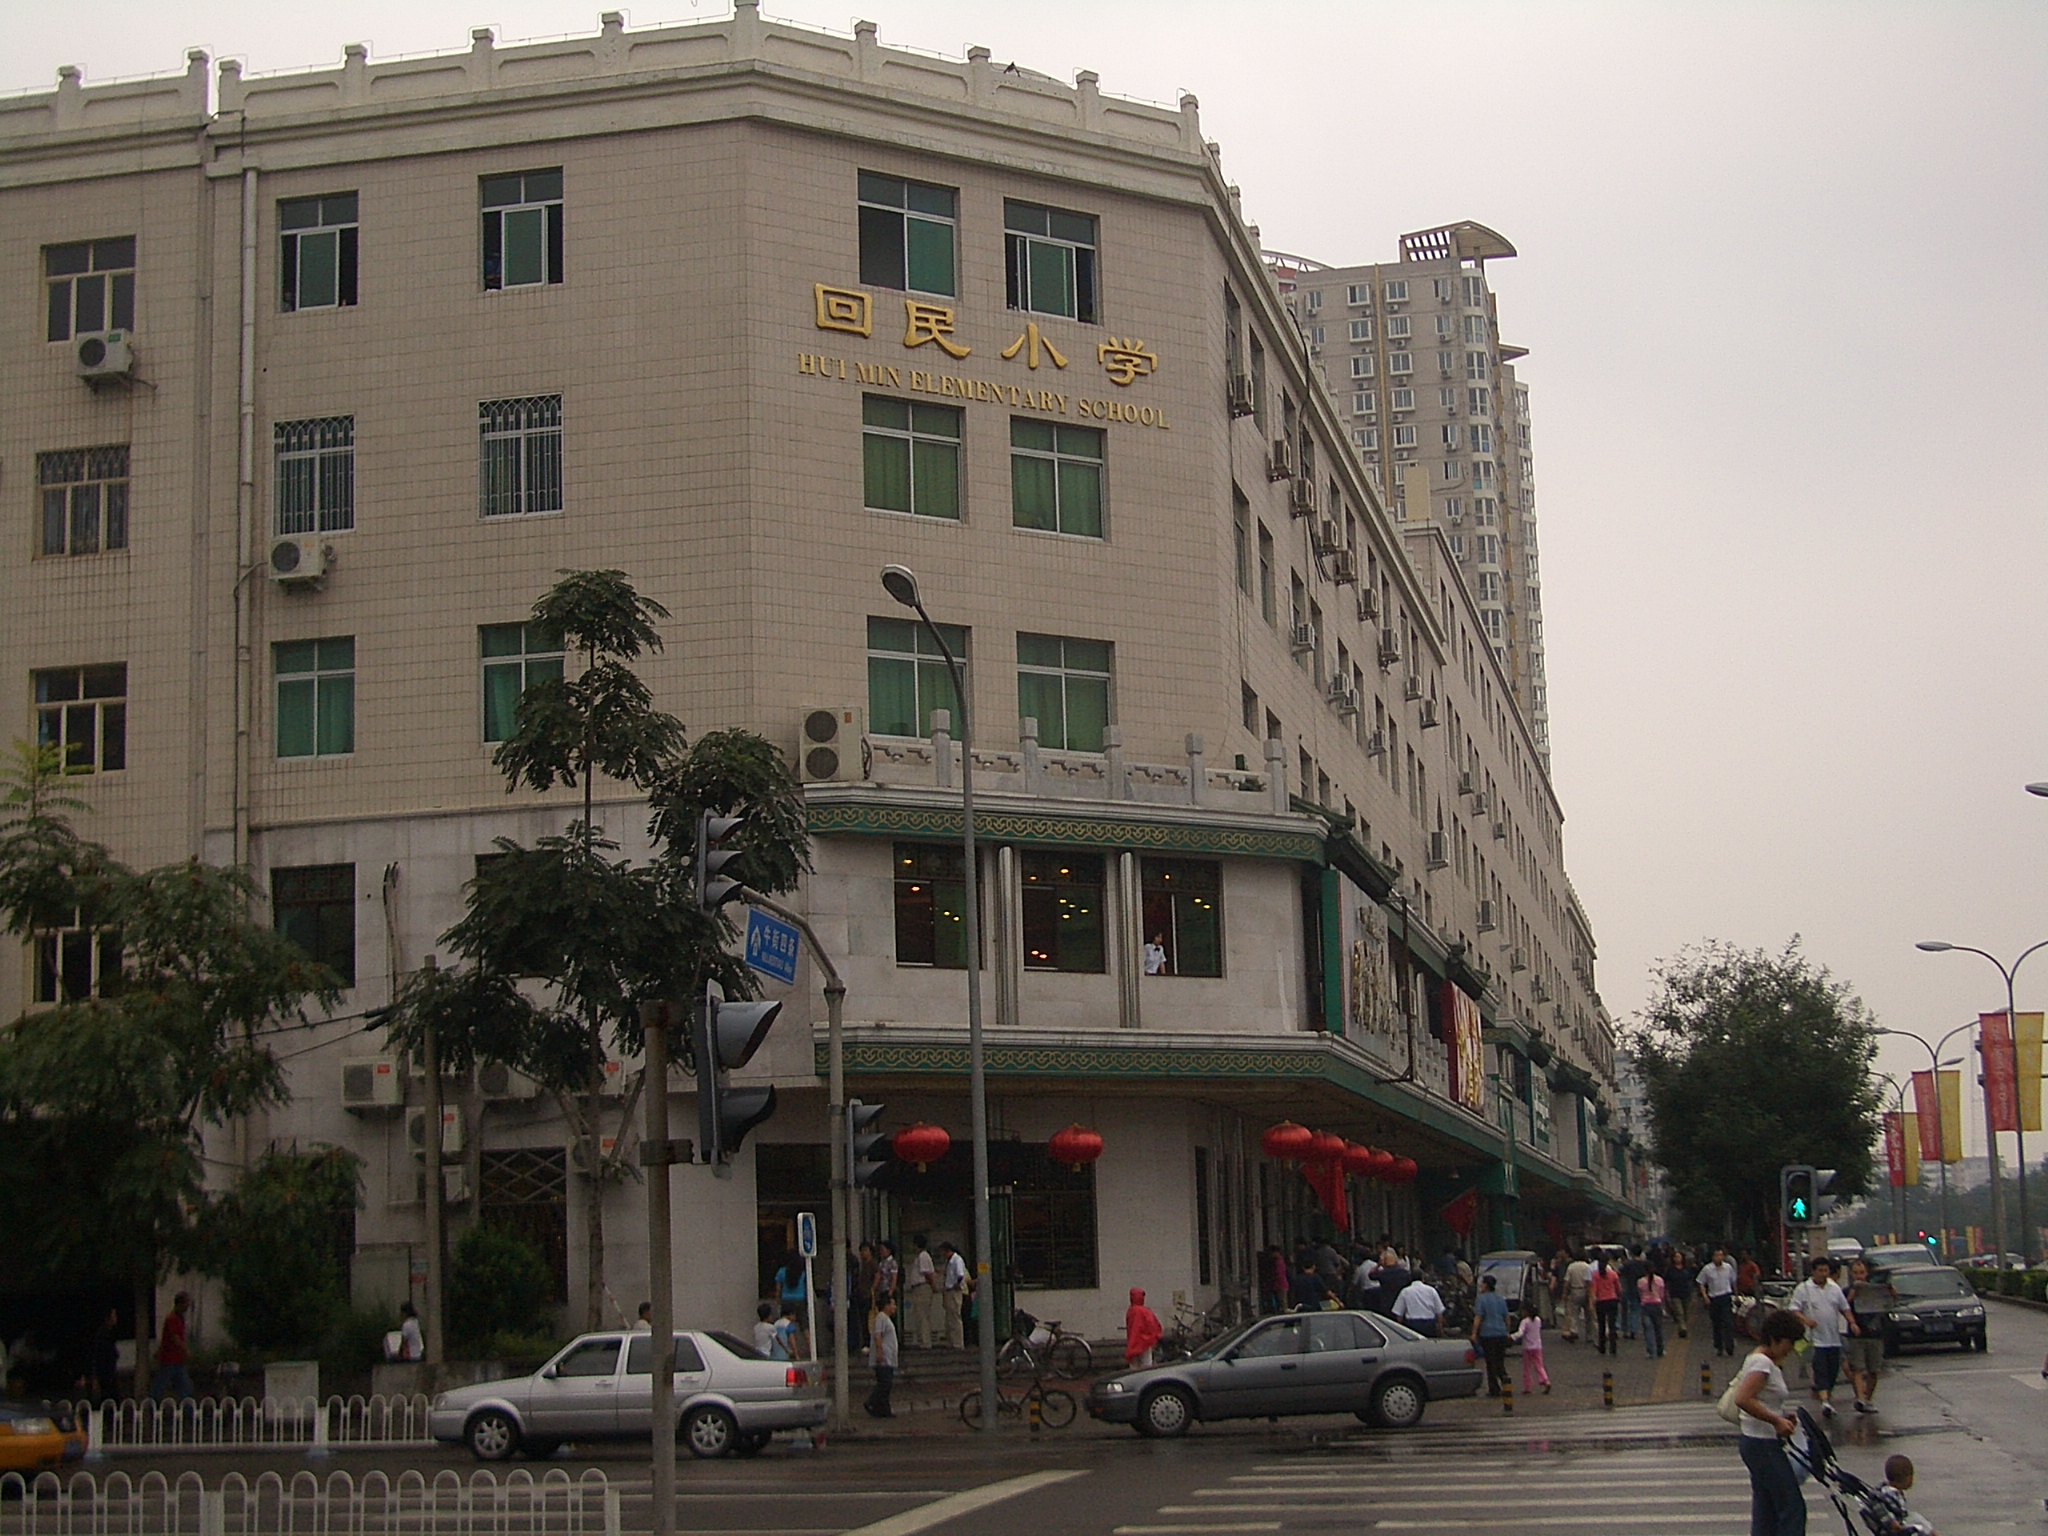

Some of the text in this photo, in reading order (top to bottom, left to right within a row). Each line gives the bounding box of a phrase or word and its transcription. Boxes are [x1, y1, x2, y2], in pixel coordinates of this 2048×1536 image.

[814, 283, 1158, 386] 回民小学
[798, 353, 1171, 430] HUI MIN ELEMENTARY SCHOOL
